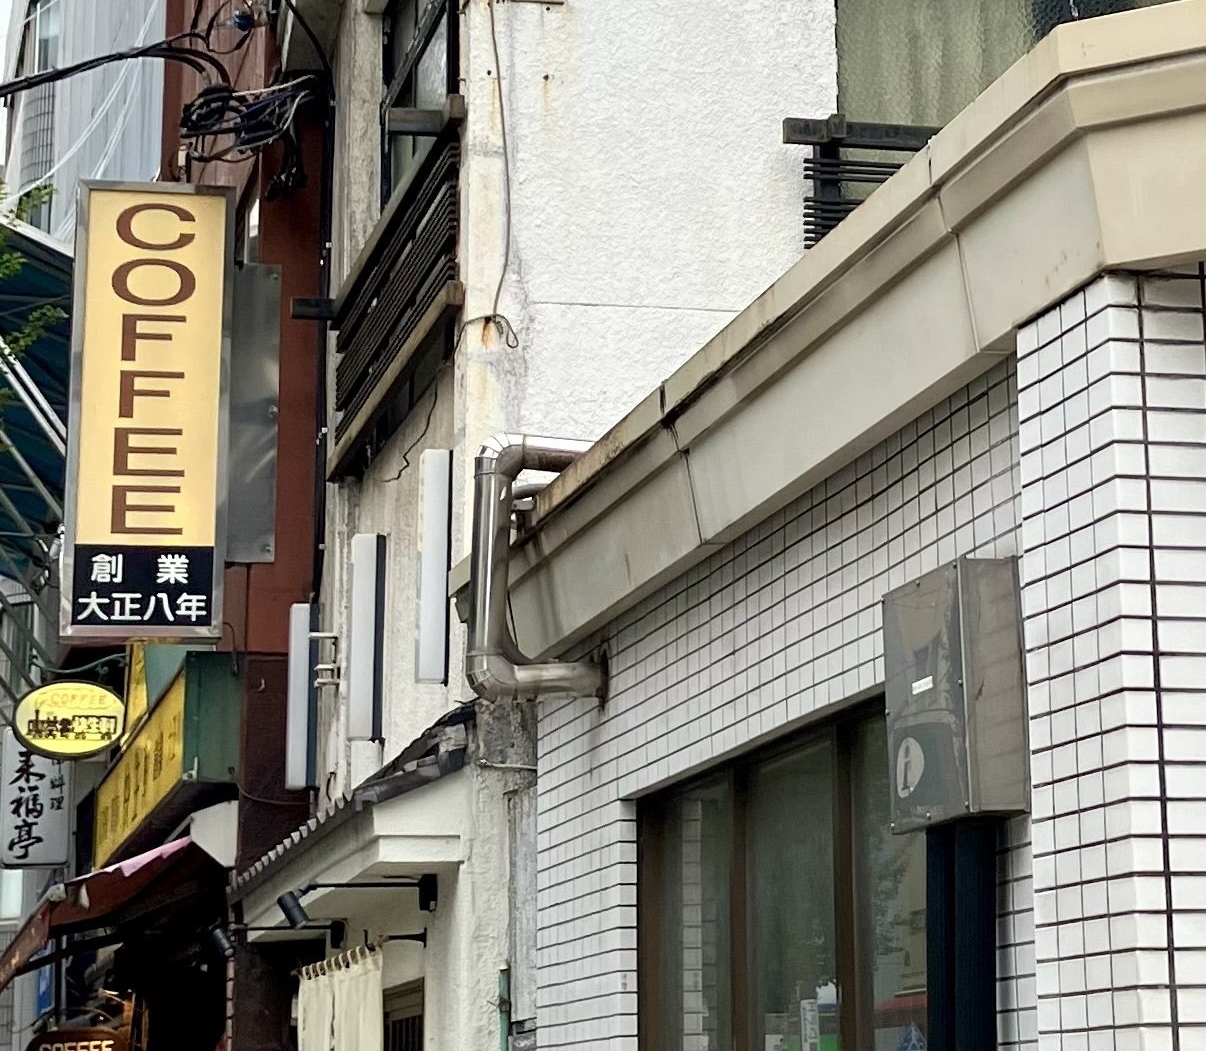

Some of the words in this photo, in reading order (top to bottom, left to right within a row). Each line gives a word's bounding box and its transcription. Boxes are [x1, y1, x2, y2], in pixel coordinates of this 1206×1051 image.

[110, 202, 196, 536] COFFEE
[90, 553, 190, 584] 創業
[77, 592, 207, 622] 大正八年
[50, 693, 108, 708] COFFEE
